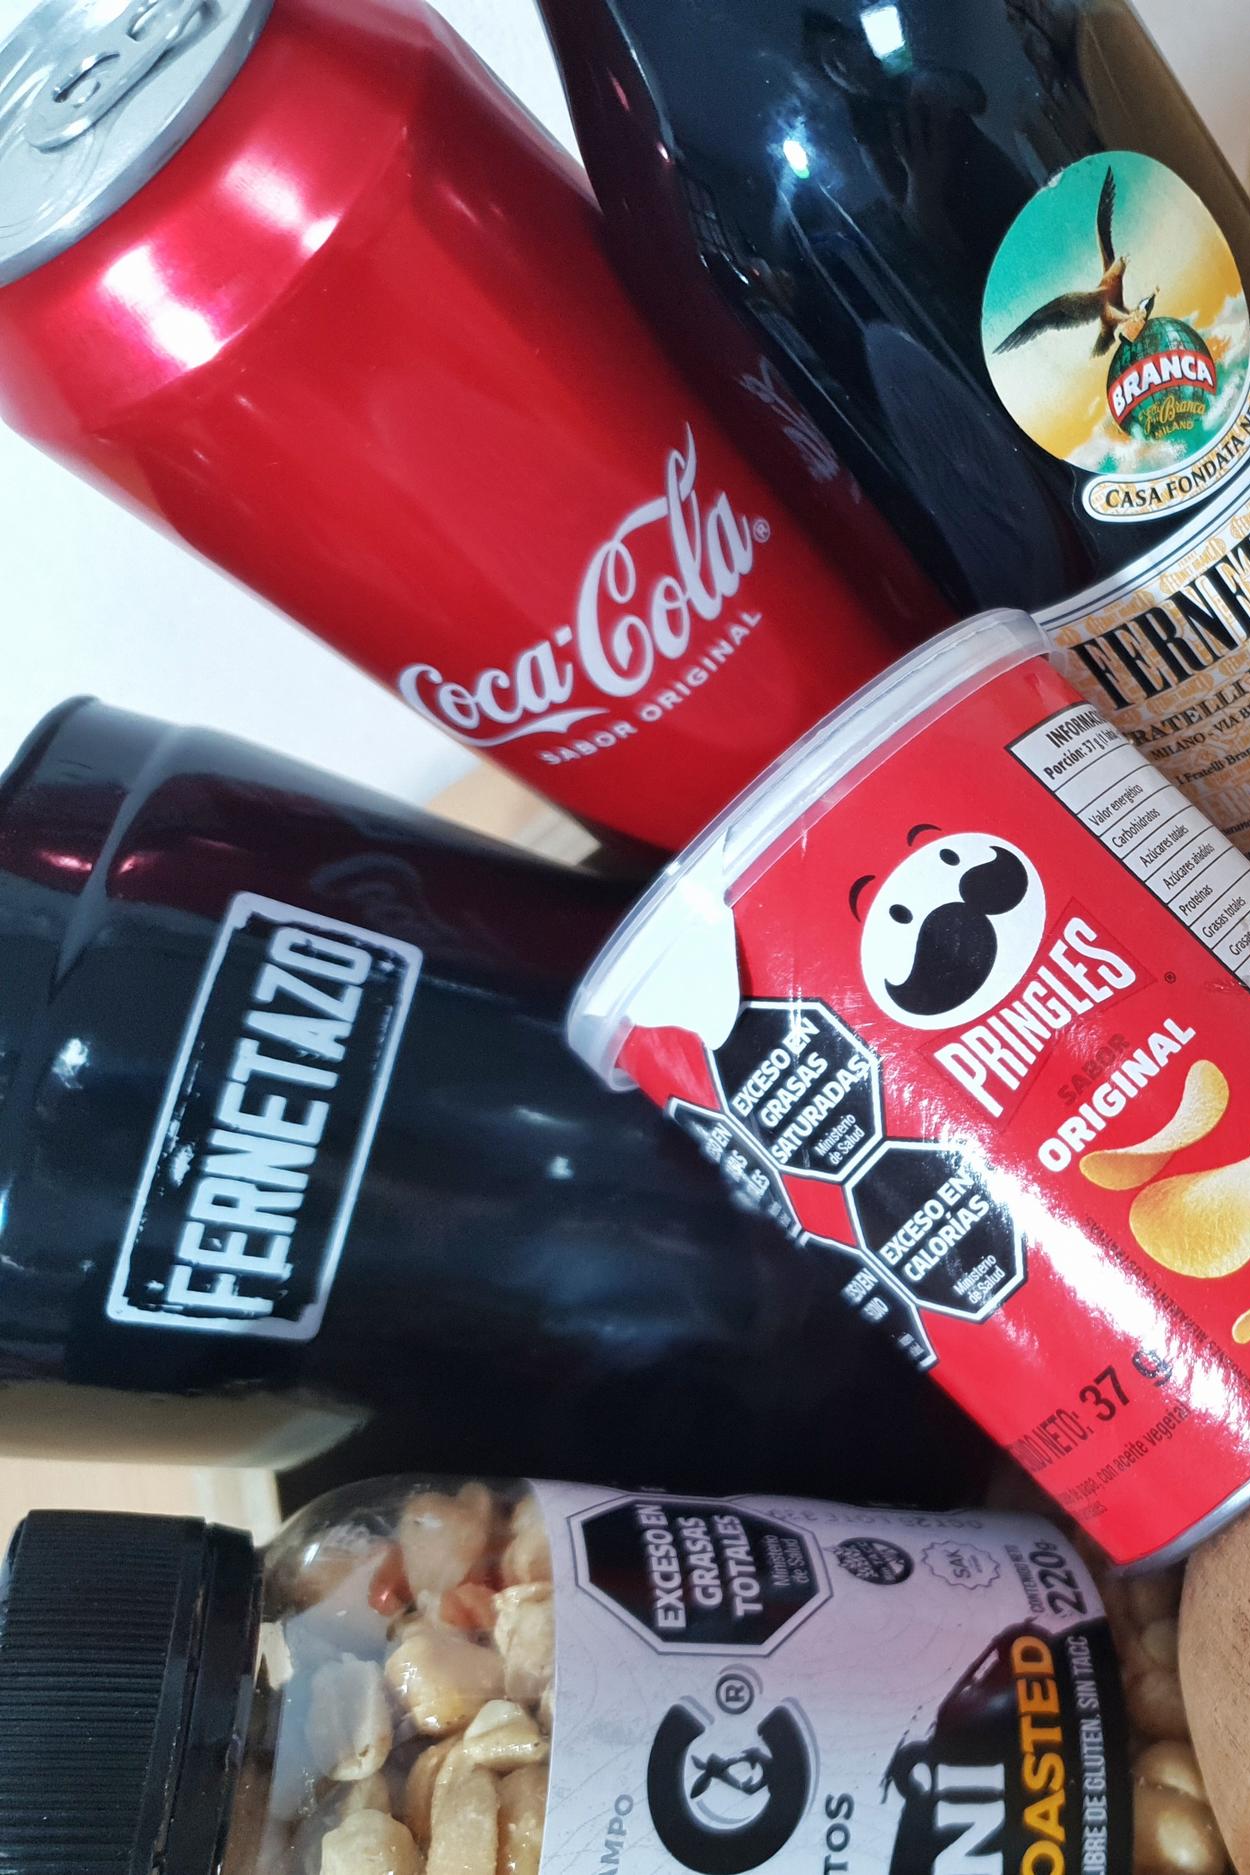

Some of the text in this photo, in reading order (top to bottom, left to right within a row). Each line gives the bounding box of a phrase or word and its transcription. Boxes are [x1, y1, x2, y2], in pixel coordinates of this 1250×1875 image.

[1112, 355, 1213, 417] BRANCA
[1106, 488, 1162, 508] CASA
[1167, 436, 1245, 498] FONDATA
[398, 421, 754, 747] Coca-Cola
[537, 611, 762, 765] SABOR ORIGINAL
[1123, 677, 1249, 747] RATELLI
[1043, 745, 1087, 780] Porción:
[1086, 737, 1099, 755] 37
[1152, 733, 1205, 761] MILANO
[1213, 716, 1240, 737] VIA
[1184, 757, 1225, 784] Fratelli
[1088, 783, 1144, 827] Valor energético
[1112, 808, 1161, 848] Carbohidratos
[1139, 824, 1190, 868] Azúcares totales
[1162, 858, 1196, 890] Azúcares
[1178, 883, 1213, 917] Proteínas
[1202, 896, 1247, 939] Grasas totales
[933, 917, 1136, 1118] PRINGLES
[732, 1049, 791, 1117] EXCESO
[783, 1017, 820, 1057] EN
[759, 1052, 828, 1128] GRASAS
[1057, 1033, 1131, 1106] SABOR
[166, 926, 372, 1316] FERNETAZO
[770, 1053, 872, 1166] SATURADAS
[1038, 1018, 1197, 1172] ORIGINAL
[814, 1113, 857, 1158] Ministerio
[830, 1126, 866, 1166] de Salud
[880, 1168, 977, 1265] EXCESO EN
[902, 1195, 991, 1283] CALORÍAS
[953, 1254, 998, 1297] Ministerio
[967, 1266, 1006, 1304] de Salud
[1079, 1365, 1130, 1422] 37
[1097, 1462, 1119, 1486] con
[1113, 1437, 1149, 1473] aceite
[634, 1503, 687, 1629] EXCESO EN
[676, 1516, 723, 1609] GRASAS
[711, 1514, 764, 1617] TOTALES
[763, 1533, 791, 1587] Ministerio
[783, 1537, 810, 1584] de Salud
[1066, 1635, 1094, 1679] TACC
[1075, 1680, 1100, 1710] SIN
[1082, 1792, 1108, 1824] DE
